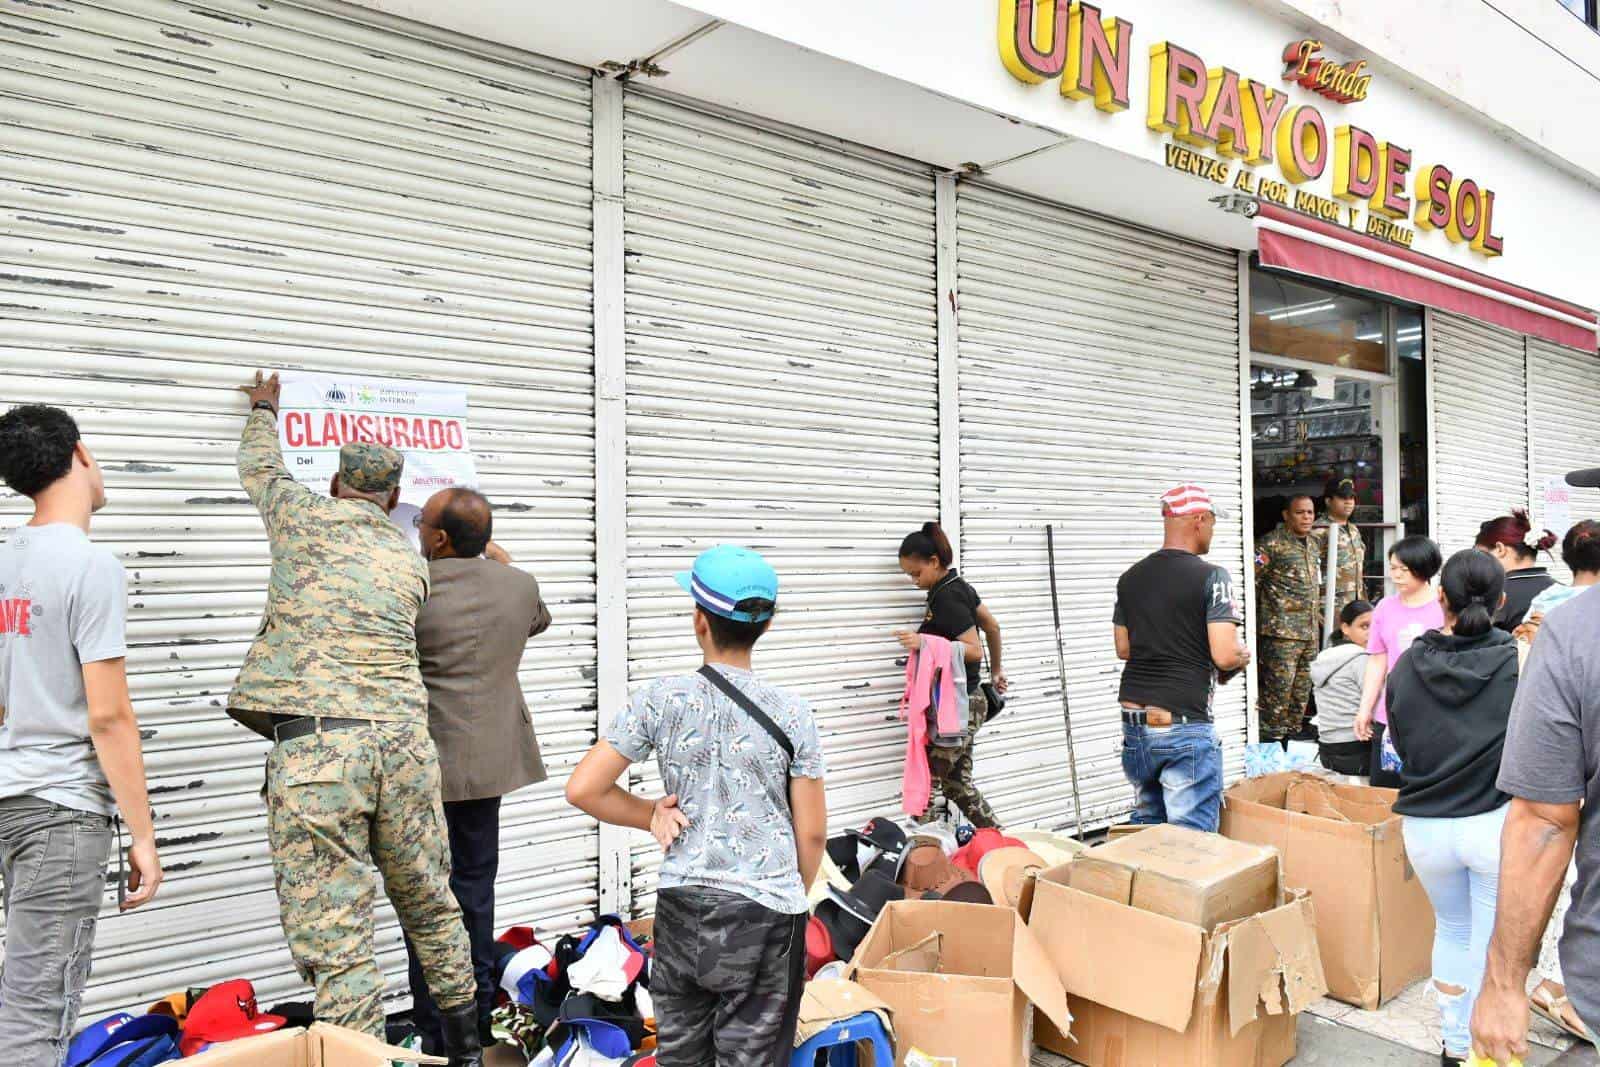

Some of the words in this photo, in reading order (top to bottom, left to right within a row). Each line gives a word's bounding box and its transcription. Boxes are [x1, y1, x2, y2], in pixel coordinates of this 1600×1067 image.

[1282, 39, 1371, 104] Tienda
[998, 0, 1133, 113] UN
[1147, 41, 1327, 187] RAYO
[1332, 123, 1412, 220] DE
[1413, 164, 1504, 256] SOL
[1164, 142, 1228, 184] VENTAS
[1233, 169, 1253, 194] AL
[1258, 177, 1288, 204] POR
[1294, 190, 1340, 222] MAYOR
[1348, 207, 1360, 228] Y
[1367, 215, 1415, 249] DETALLE
[285, 411, 464, 449] CLAUSURADO
[296, 456, 313, 465] Del
